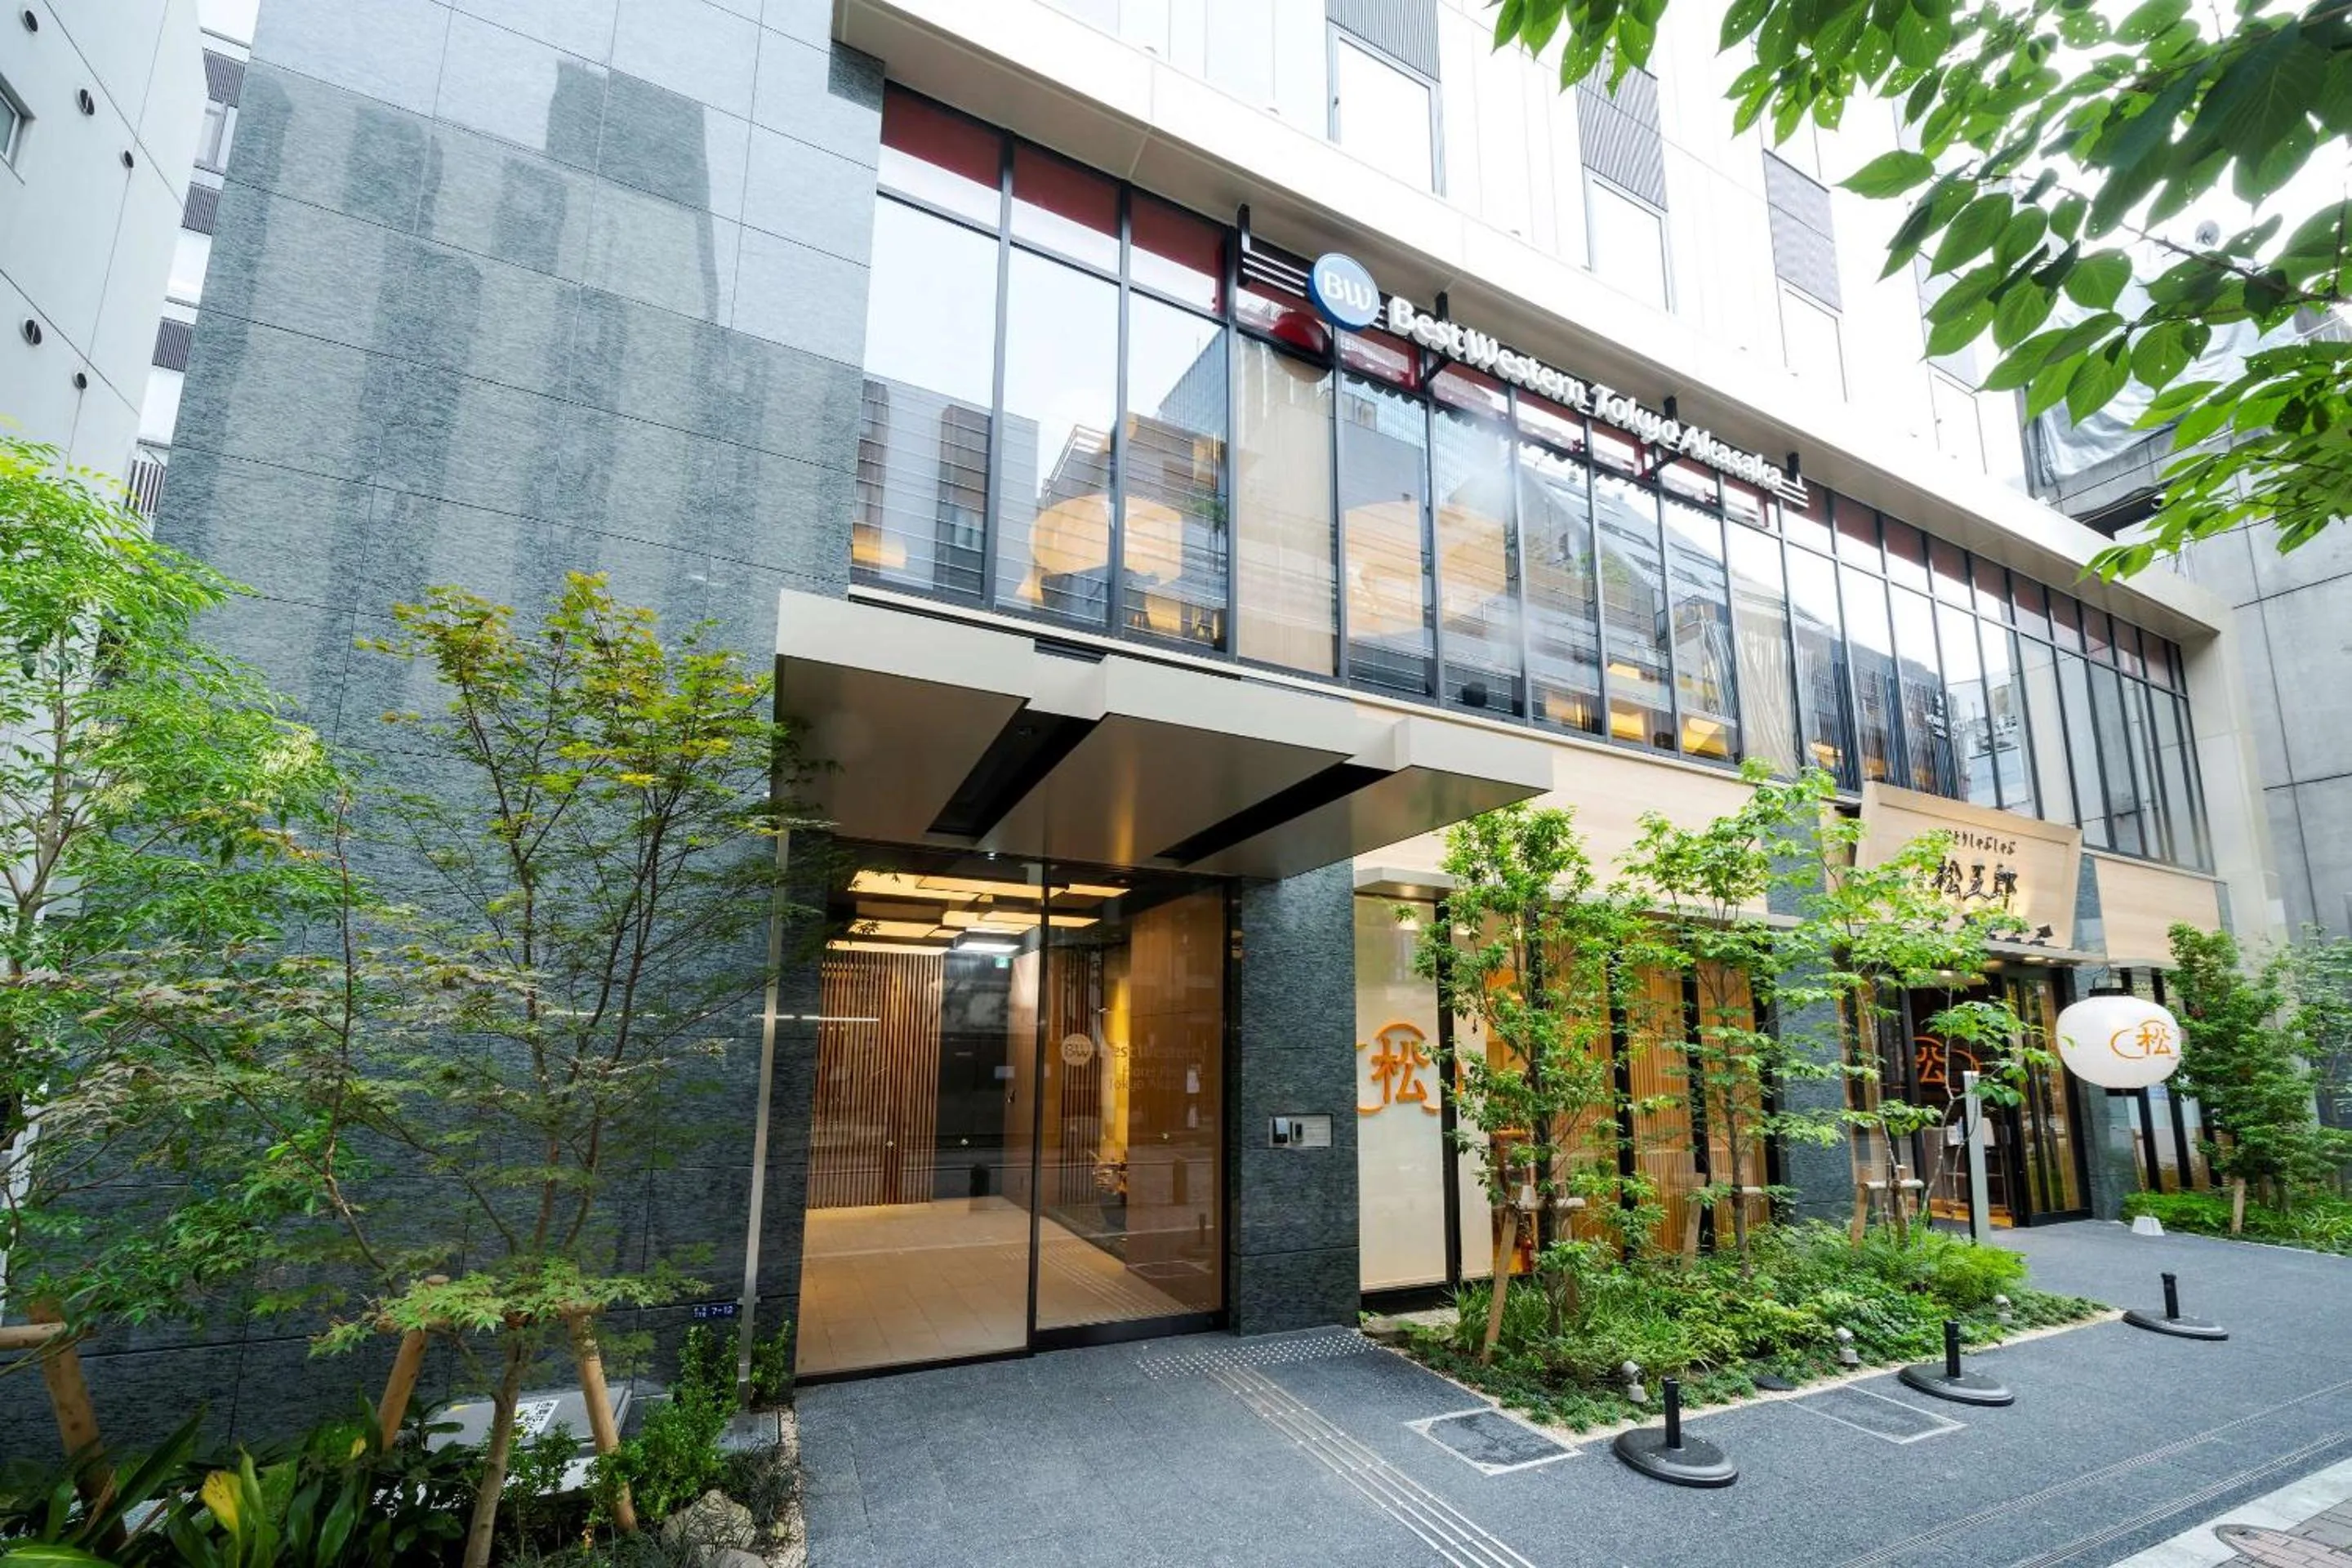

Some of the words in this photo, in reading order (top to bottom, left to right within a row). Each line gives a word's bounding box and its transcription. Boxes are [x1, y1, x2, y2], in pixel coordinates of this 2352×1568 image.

[1322, 270, 1372, 311] BW
[1388, 296, 1464, 359] Best
[1463, 327, 1589, 408] Western
[1590, 383, 1681, 446] Tokyo
[1679, 425, 1783, 490] Akasaka
[2136, 1026, 2172, 1055] 松
[1370, 1038, 1431, 1105] 松
